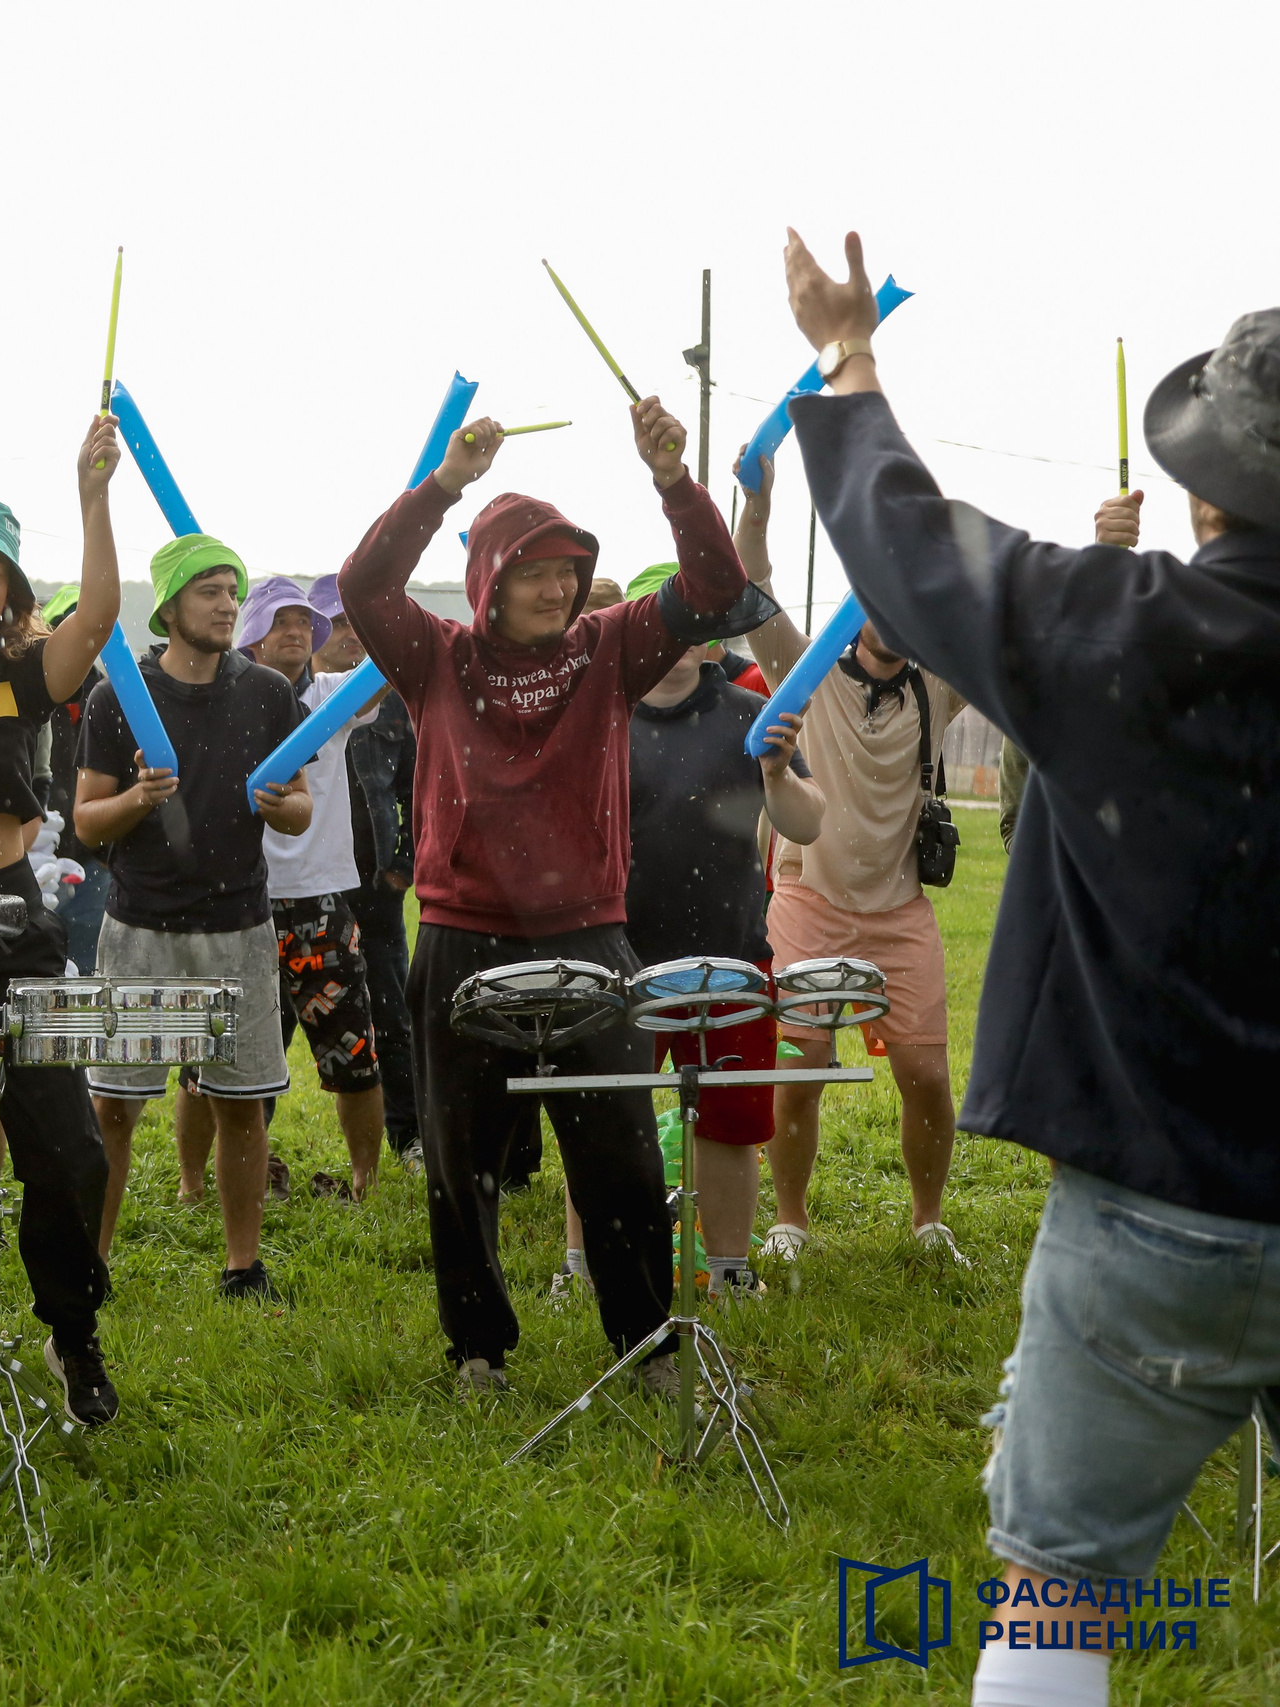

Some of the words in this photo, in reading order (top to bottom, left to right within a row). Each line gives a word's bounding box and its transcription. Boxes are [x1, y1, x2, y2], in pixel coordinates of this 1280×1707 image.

[294, 914, 329, 941] FILA
[301, 981, 348, 1027] FILA
[320, 1031, 366, 1077] FILA
